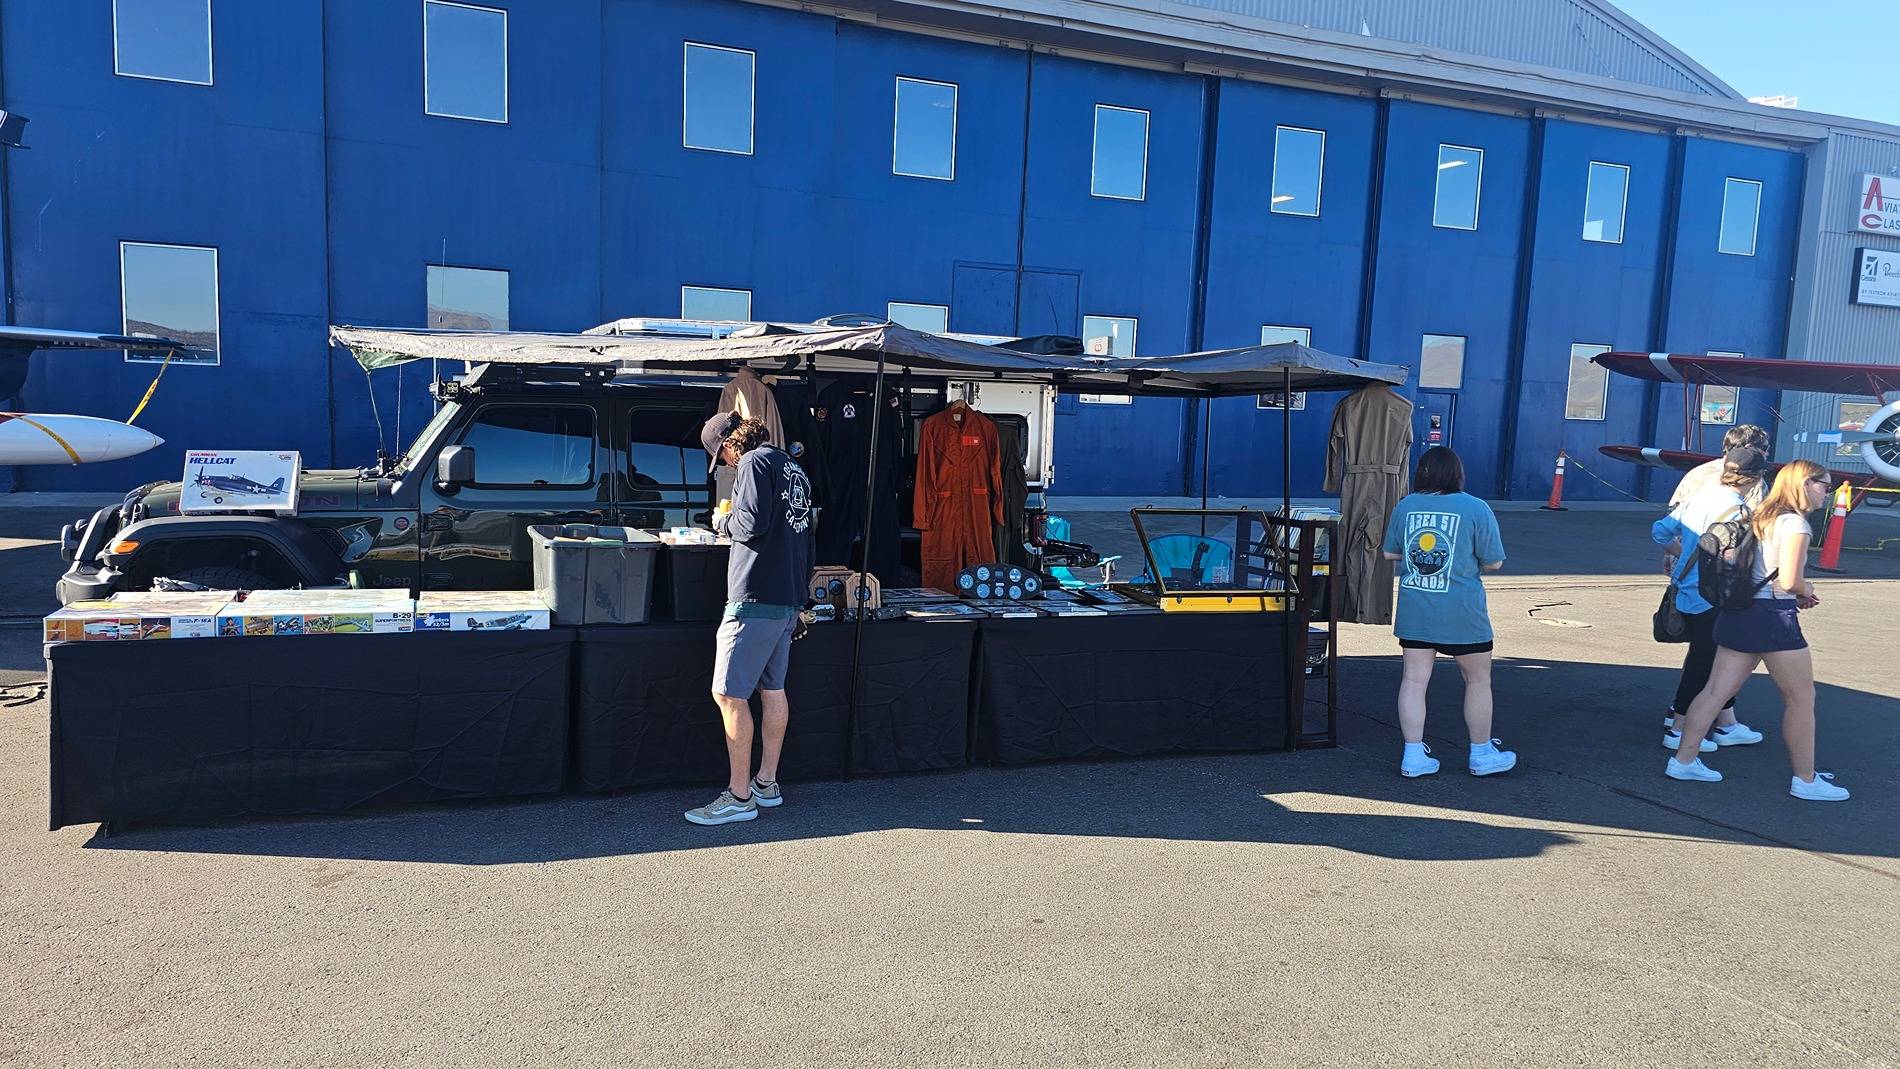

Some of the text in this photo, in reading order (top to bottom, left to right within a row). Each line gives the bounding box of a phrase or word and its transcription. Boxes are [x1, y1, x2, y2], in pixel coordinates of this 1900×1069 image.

[1863, 177, 1900, 214] AVIA
[189, 457, 237, 465] HELLCAT
[1409, 515, 1456, 537] AREA 51
[373, 575, 411, 587] Jeep
